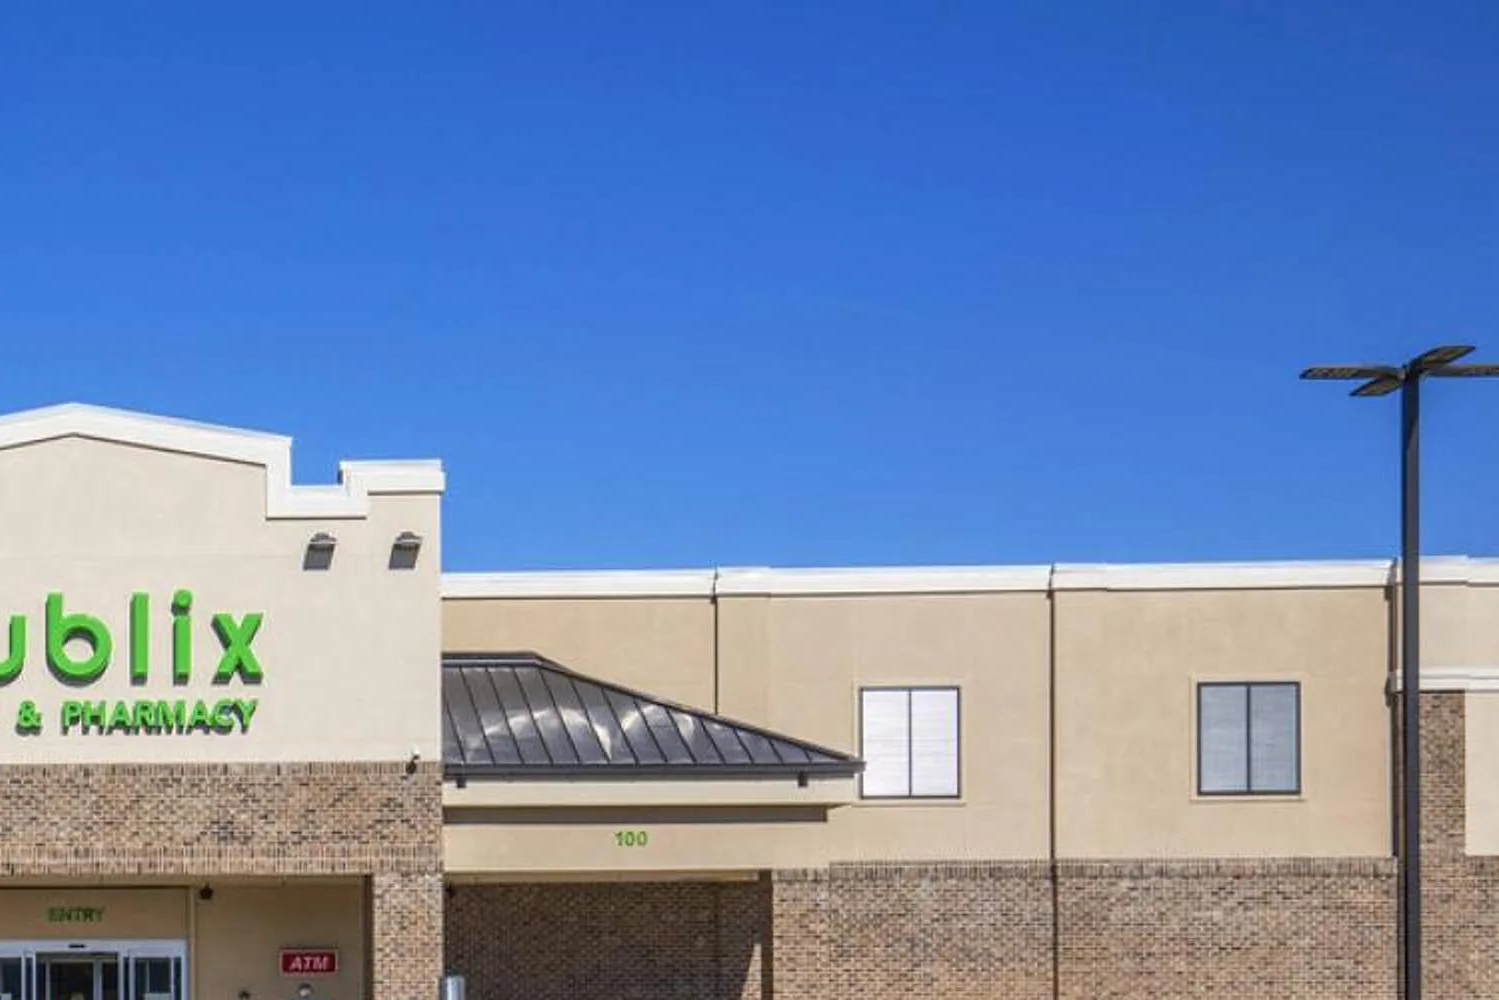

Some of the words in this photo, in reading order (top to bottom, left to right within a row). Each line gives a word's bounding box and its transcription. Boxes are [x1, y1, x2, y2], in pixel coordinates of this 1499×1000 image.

[15, 701, 42, 736] &
[60, 700, 258, 736] PHARMACY
[613, 831, 648, 847] 100
[49, 906, 106, 922] ENTRY
[289, 955, 329, 971] ATM
